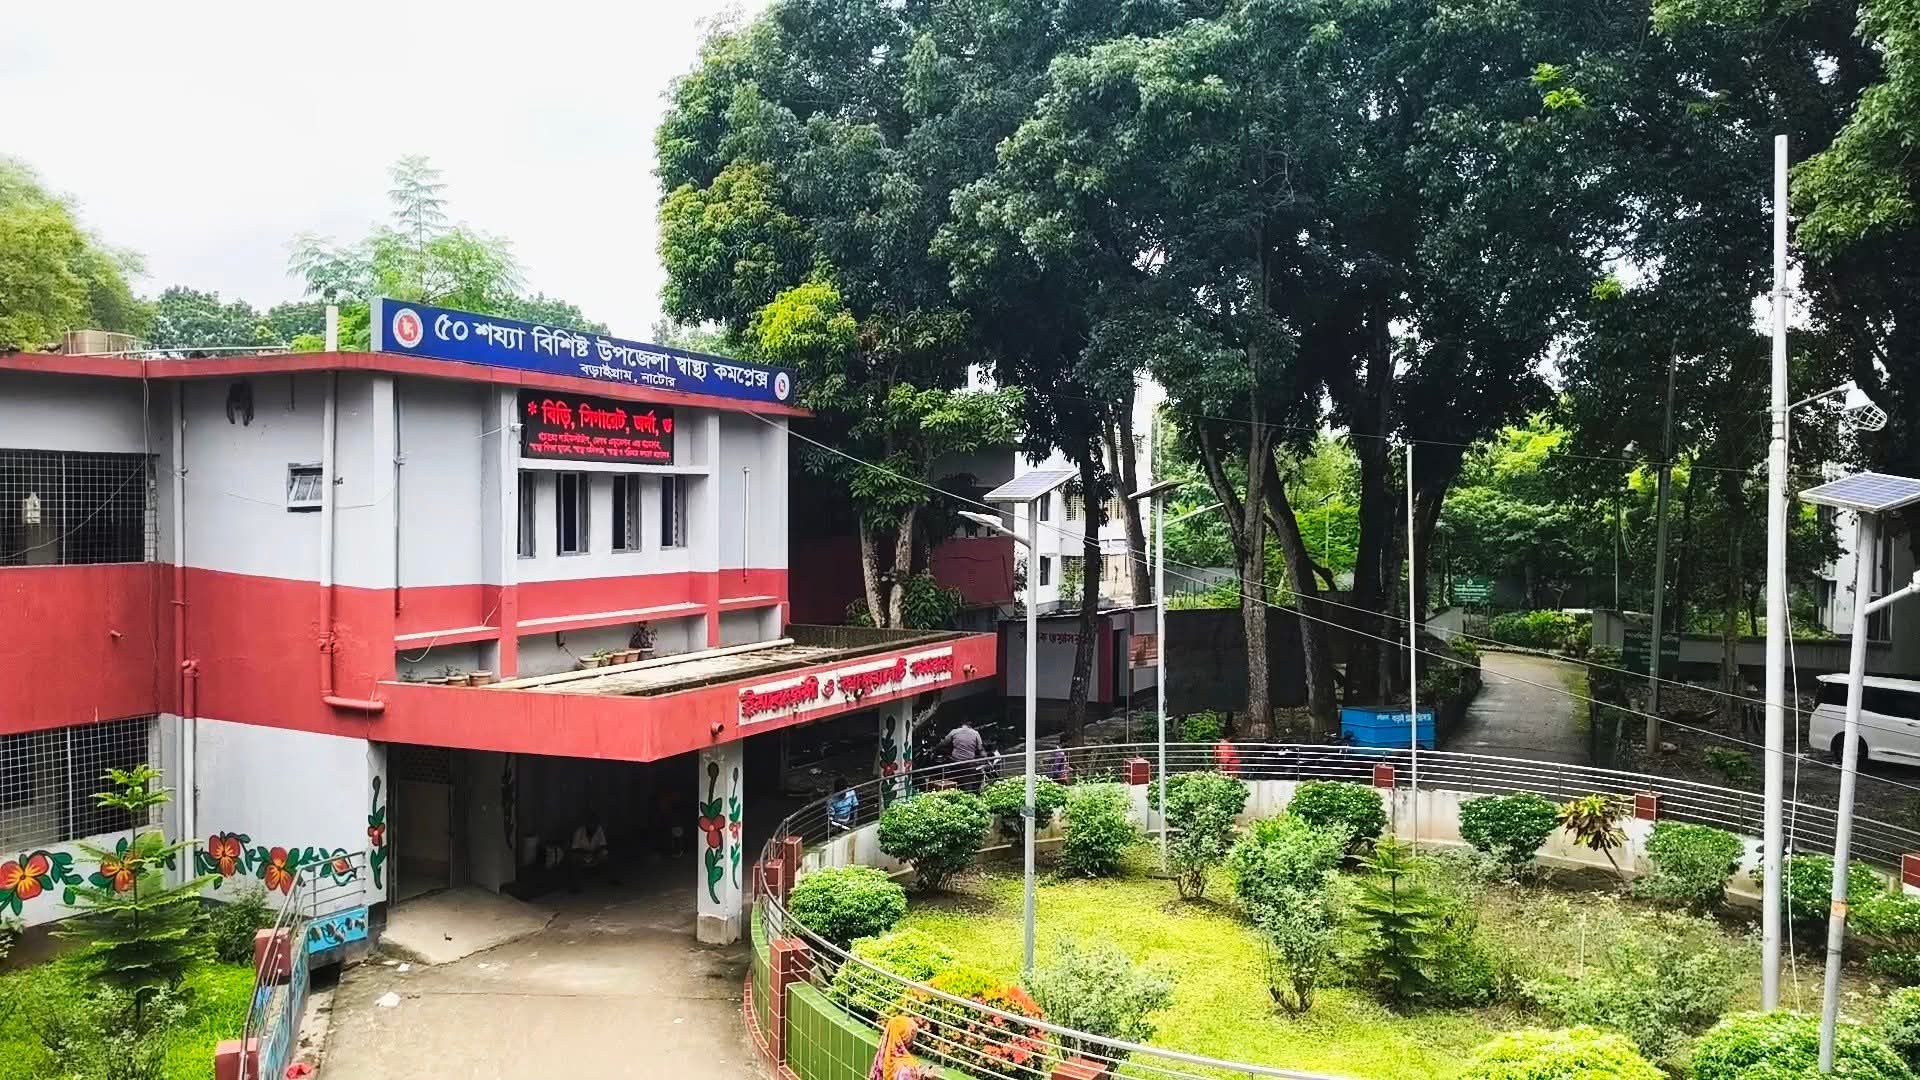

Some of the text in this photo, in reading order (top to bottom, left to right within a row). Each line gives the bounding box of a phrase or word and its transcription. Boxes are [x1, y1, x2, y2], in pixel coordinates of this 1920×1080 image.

[434, 313, 770, 389] ৫০ শয্যা বিশিষ্ট উপজেলা স্বাস্থ্য কমপ্লেক্স
[640, 369, 676, 388] নাটোর
